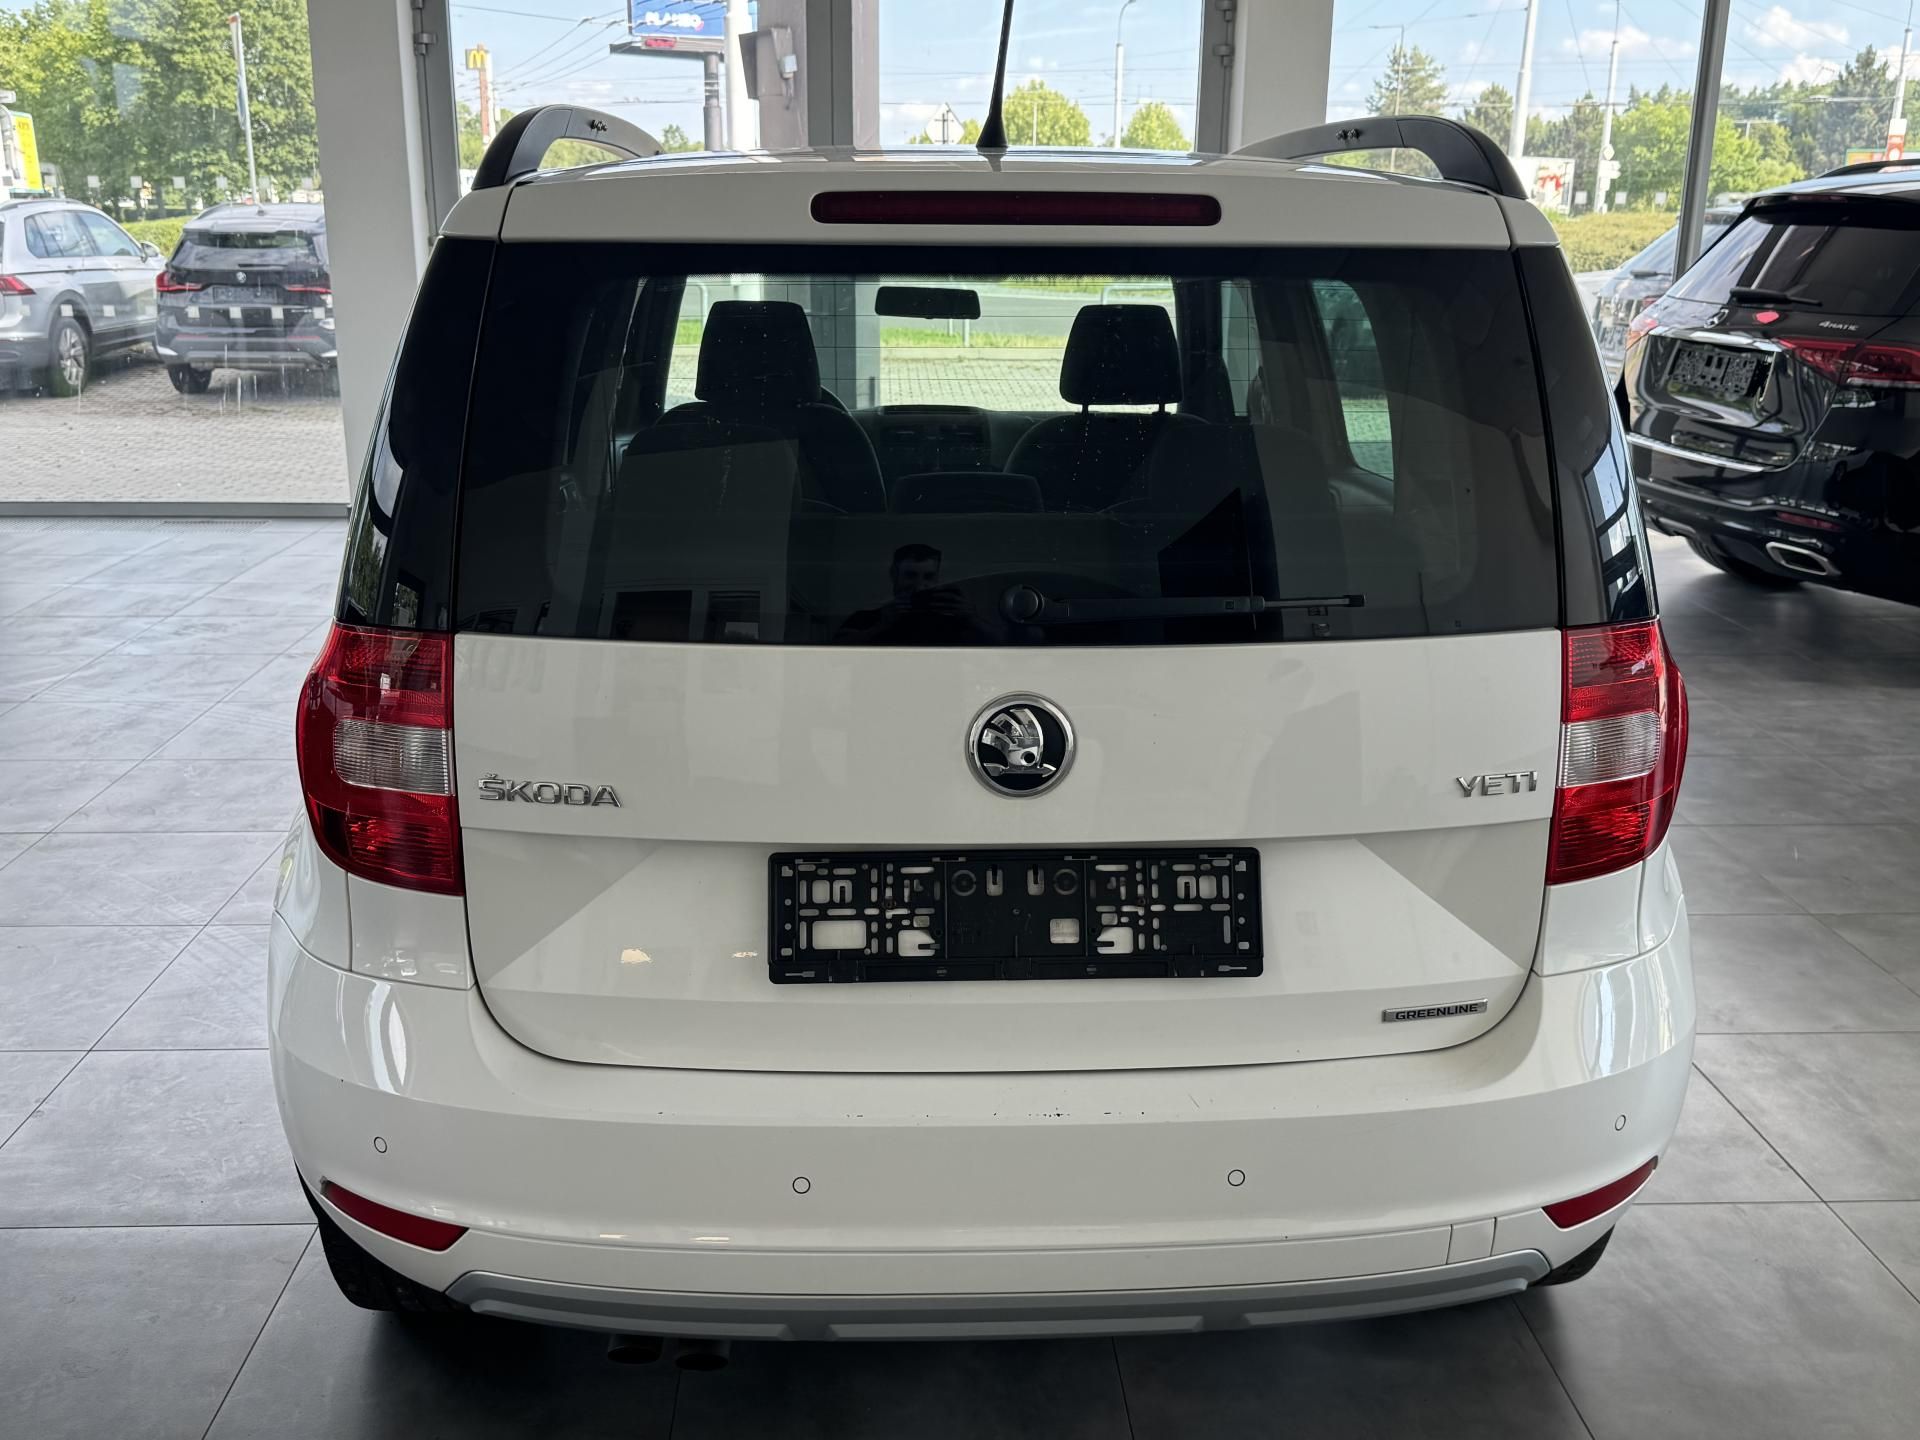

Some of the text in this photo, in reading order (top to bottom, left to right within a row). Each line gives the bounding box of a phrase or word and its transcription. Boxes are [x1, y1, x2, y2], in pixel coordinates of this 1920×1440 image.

[478, 772, 621, 808] ŠKODA
[1456, 771, 1537, 797] YETI
[1395, 1003, 1479, 1020] GREENLINE
